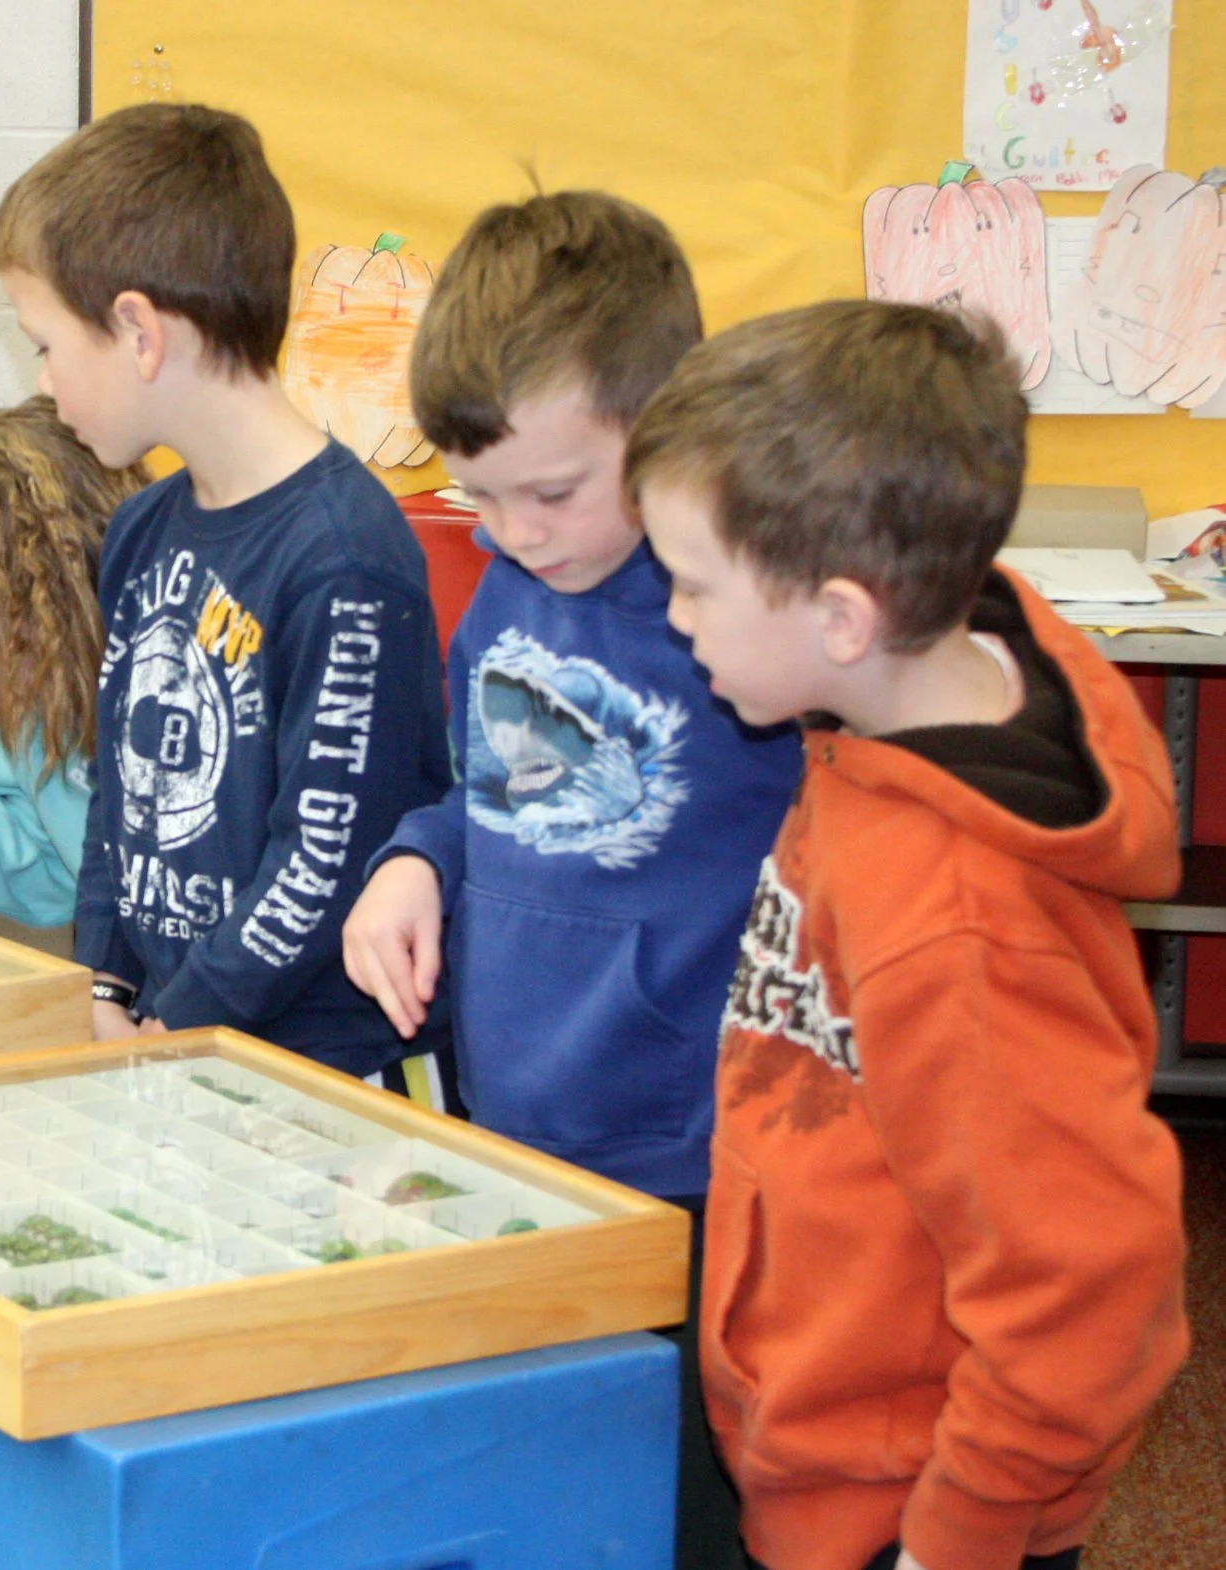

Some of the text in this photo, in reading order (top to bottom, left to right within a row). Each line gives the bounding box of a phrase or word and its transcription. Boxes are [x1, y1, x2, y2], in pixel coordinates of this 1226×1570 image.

[196, 586, 264, 672] MVP
[159, 713, 189, 767] 8
[240, 597, 385, 969] POINT GUARD
